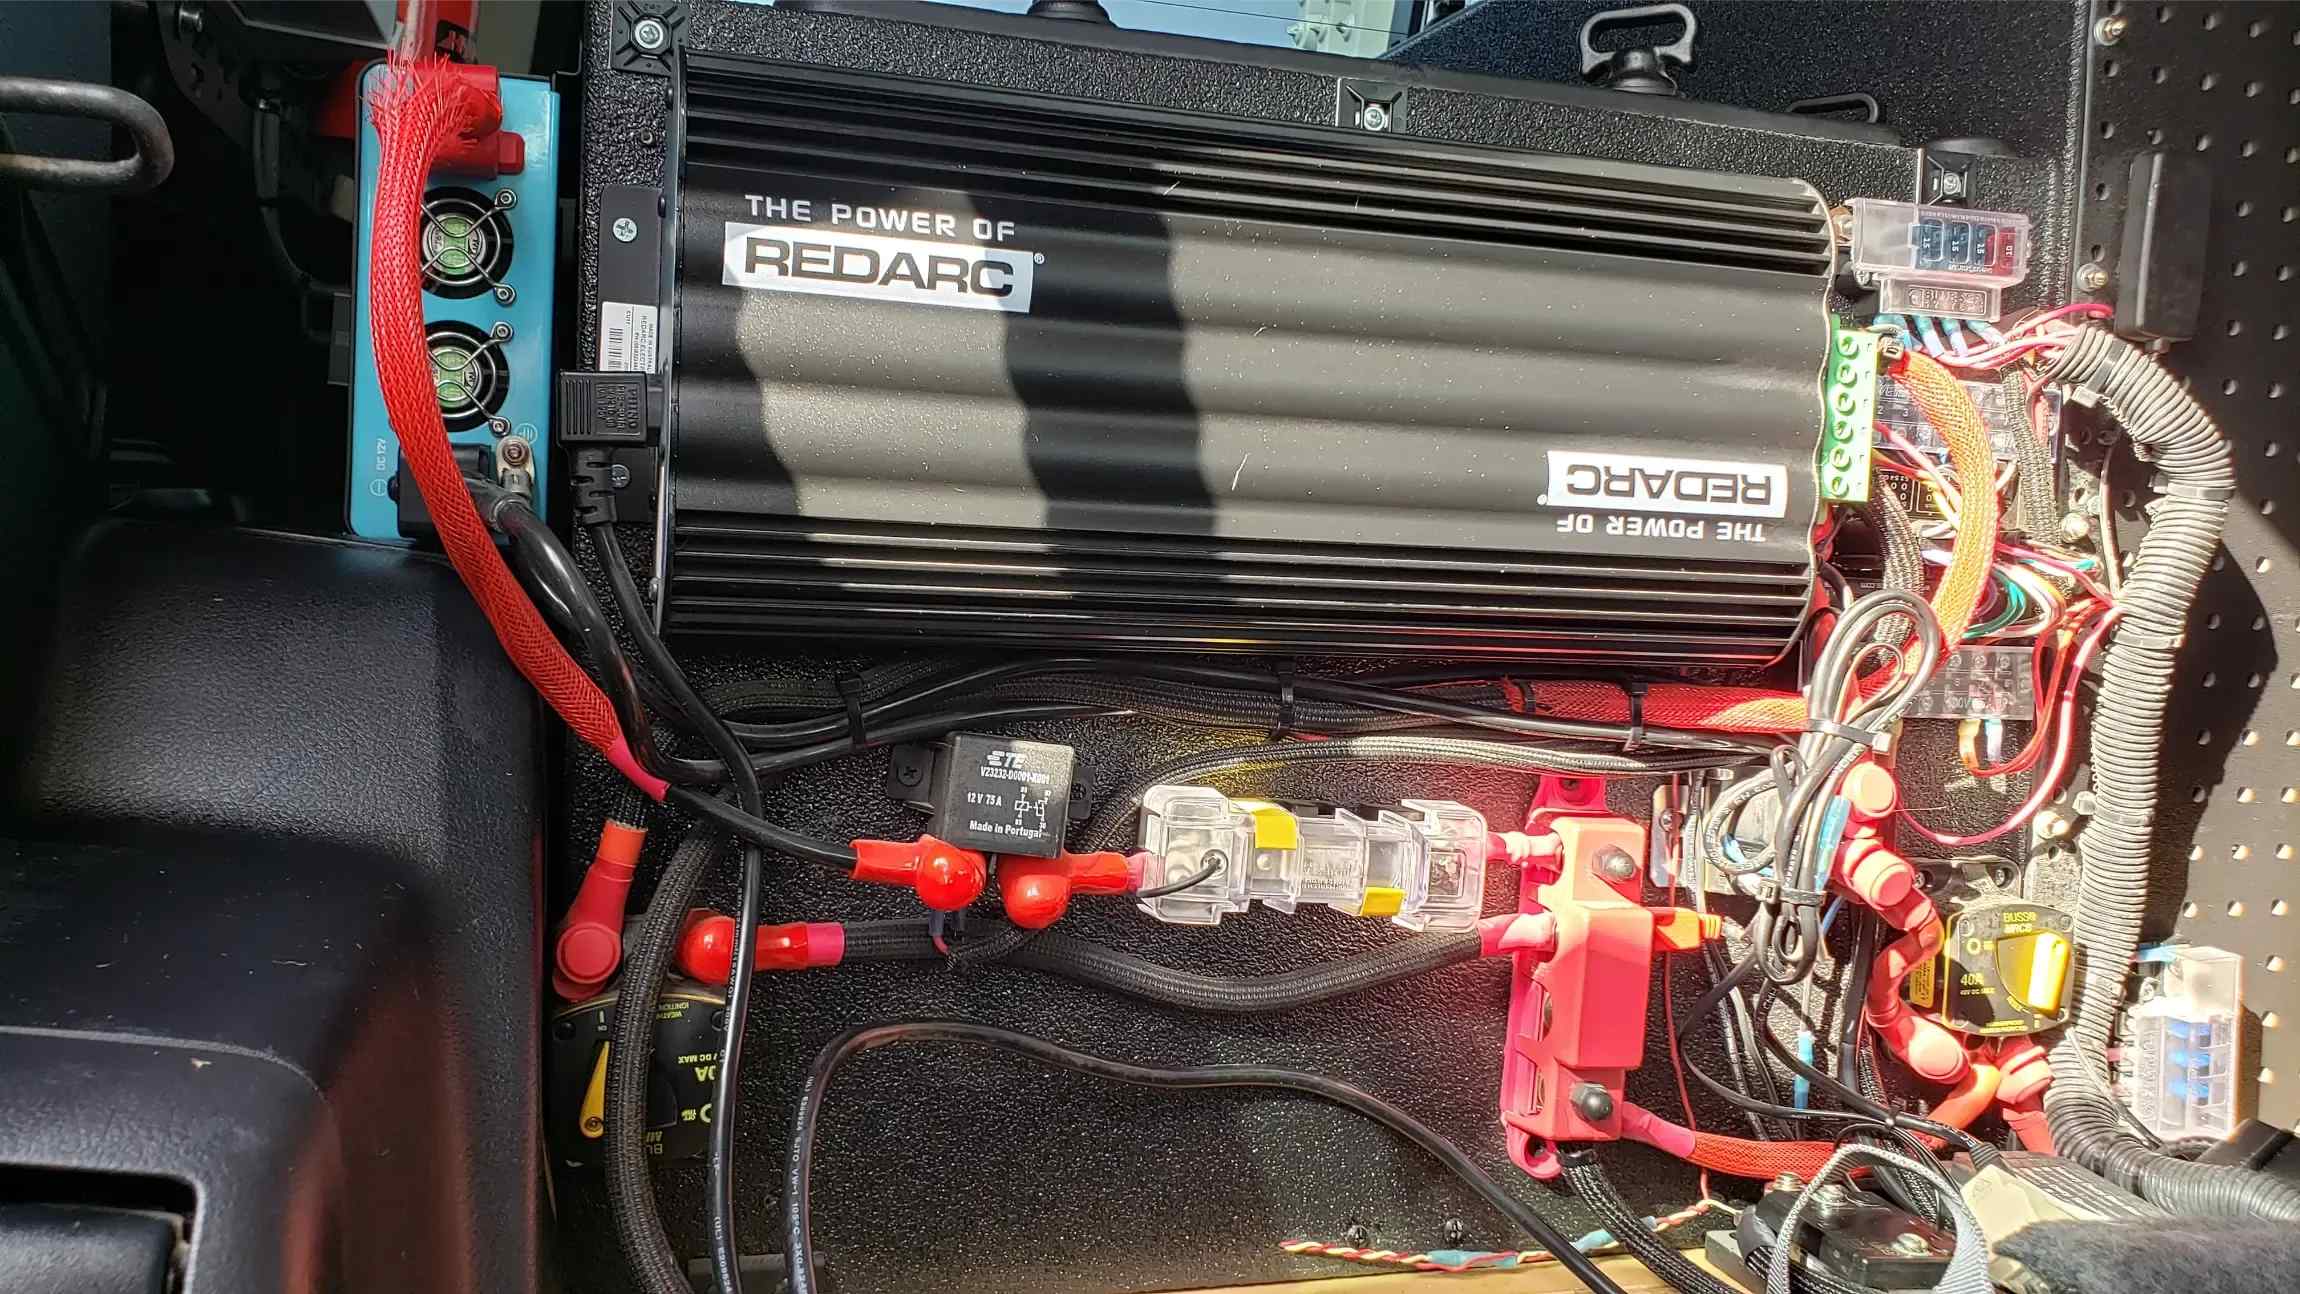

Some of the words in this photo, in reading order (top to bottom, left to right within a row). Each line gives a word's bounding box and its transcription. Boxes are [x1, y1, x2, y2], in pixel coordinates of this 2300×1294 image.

[745, 194, 812, 222] THE
[831, 203, 956, 237] POWER
[973, 217, 1015, 242] OF
[745, 236, 1014, 298] REDARC
[1567, 464, 1771, 506] REDARC
[1557, 513, 1594, 533] OF
[1606, 516, 1704, 539] POWER
[1716, 522, 1766, 542] THE
[970, 820, 993, 833] Made
[995, 823, 1003, 833] in
[1005, 826, 1042, 839] Portugal
[1960, 972, 1984, 986] 40A
[678, 1055, 698, 1064] MAX
